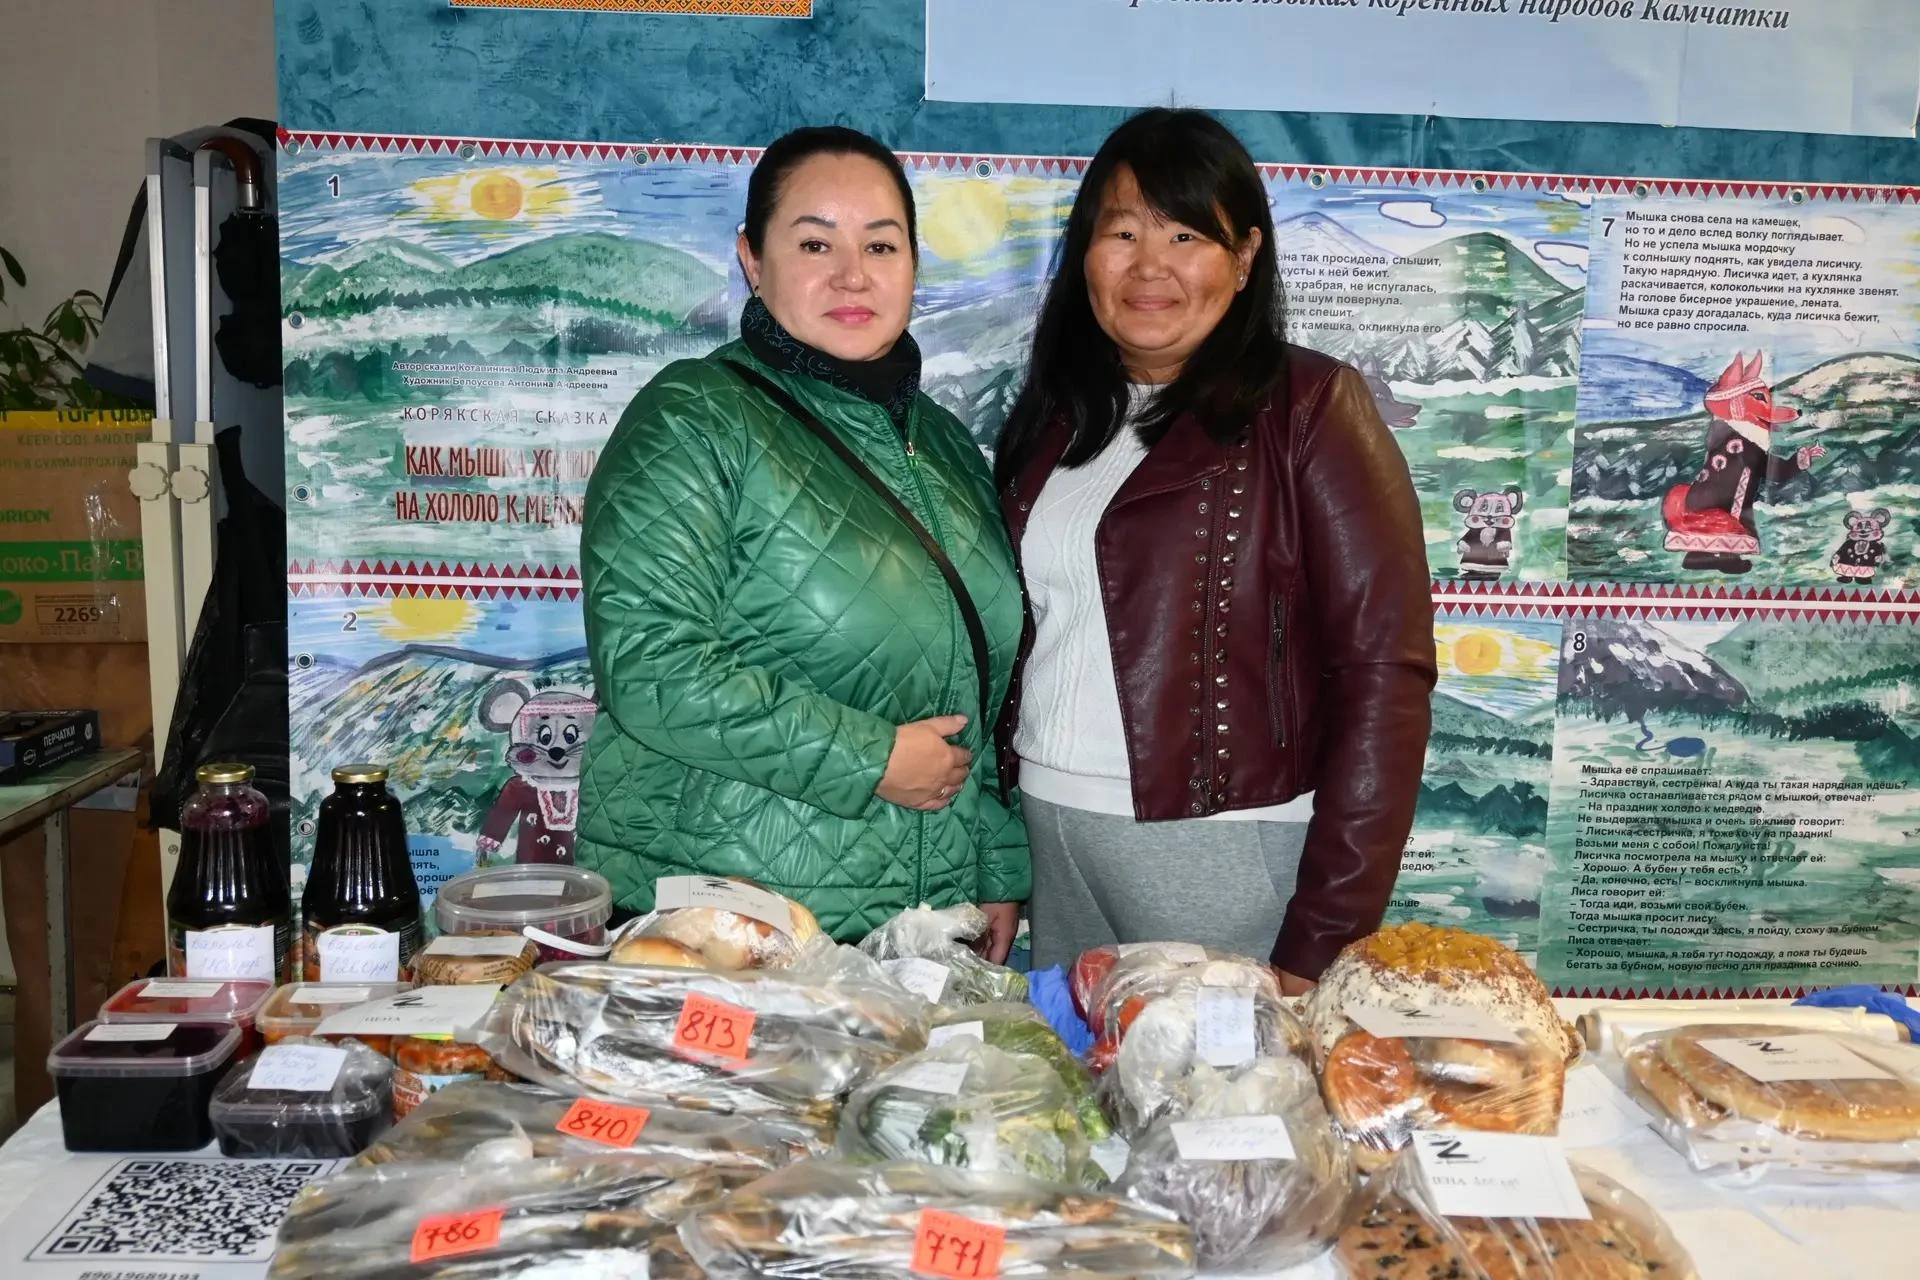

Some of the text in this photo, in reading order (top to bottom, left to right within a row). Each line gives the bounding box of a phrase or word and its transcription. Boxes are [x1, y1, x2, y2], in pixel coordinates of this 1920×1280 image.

[1518, 0, 1634, 24] народов
[1640, 1, 1791, 29] Камчатки
[327, 174, 339, 197] 1
[1602, 217, 1615, 238] 7
[1626, 211, 1800, 229] Мышка снова села на камешек,
[1625, 227, 1640, 235] но
[1642, 227, 1656, 236] то
[1658, 228, 1666, 236] и
[1667, 228, 1696, 238] дело
[1699, 229, 1732, 239] вслед
[1735, 230, 1768, 241] волку
[1624, 238, 1796, 256] Но не успела мышка мордочку
[1300, 254, 1319, 262] так
[1320, 254, 1388, 267] просидела,
[1392, 257, 1442, 268] слышит,
[1623, 253, 1862, 270] к солнышку поднять, как увидела лисичку.
[1318, 268, 1325, 276] к
[1327, 266, 1349, 277] ней
[1352, 267, 1390, 278] бежит.
[1622, 265, 1658, 278] Такую
[1723, 268, 1769, 279] Лисичка
[1802, 272, 1809, 280] а
[1811, 272, 1862, 284] кухлянка
[1294, 279, 1346, 293] храбрая,
[1350, 283, 1364, 291] не
[1366, 283, 1436, 295] испугалась,
[1620, 280, 1899, 297] раскачивается, колокольчики на кухлянке звенят.
[1290, 294, 1304, 302] на
[1308, 294, 1333, 305] шум
[1336, 295, 1402, 307] повернула.
[1620, 291, 1635, 302] На
[1679, 293, 1732, 307] бисерное
[1308, 308, 1354, 318] спешит.
[1618, 305, 1880, 323] Мышка сразу догадалась, куда лисичка бежит,
[1291, 322, 1298, 330] с
[1301, 322, 1354, 332] камешка,
[1358, 323, 1420, 335] окликнула
[1422, 325, 1444, 334] его.
[1617, 320, 1749, 335] но все равно спросила.
[392, 361, 422, 372] Автор
[424, 363, 456, 372] сказки
[566, 367, 618, 377] Андреевна
[403, 375, 450, 386] Художник
[507, 379, 554, 388] Антонина
[535, 410, 609, 425] СКАЗКА
[405, 446, 444, 476] КАК
[449, 447, 527, 478] МЫШКА
[396, 492, 420, 520] НА
[425, 492, 499, 522] ХОЛОЛО
[506, 494, 520, 522] К
[343, 612, 357, 631] 2
[1573, 632, 1586, 651] 8
[43, 725, 76, 748] ПЕРЧАТКИ
[1581, 764, 1713, 778] Мышка её спрашивает:
[1579, 788, 1626, 799] Лисичка
[1728, 793, 1762, 803] рядом
[1764, 793, 1773, 801] с
[1773, 791, 1823, 803] мышкой,
[1577, 813, 1593, 824] Не
[1660, 816, 1702, 825] мышка
[1704, 817, 1712, 825] и
[1796, 818, 1844, 828] говорит:
[1575, 838, 1620, 848] Возьми
[1619, 840, 1650, 849] меня
[1652, 841, 1661, 849] с
[1661, 839, 1700, 849] собой!
[1573, 850, 1826, 864] Лисичка посмотрела на мышку и отвечает ей:
[1401, 862, 1435, 872] ведю,
[1570, 886, 1665, 899] Лиса говорит ей:
[1569, 910, 1600, 922] Тогда
[1602, 913, 1643, 921] мышка
[1644, 913, 1684, 924] просит
[1567, 935, 1595, 945] Лиса
[1566, 960, 1603, 970] бегать
[1604, 962, 1620, 970] за
[1618, 960, 1664, 972] бубном,
[1667, 962, 1704, 972] новую
[1740, 962, 1763, 971] для
[1818, 960, 1862, 969] сочиню.
[681, 1010, 736, 1049] 813
[567, 1109, 629, 1140] 840
[423, 1219, 480, 1251] 786
[926, 1229, 986, 1277] 771
